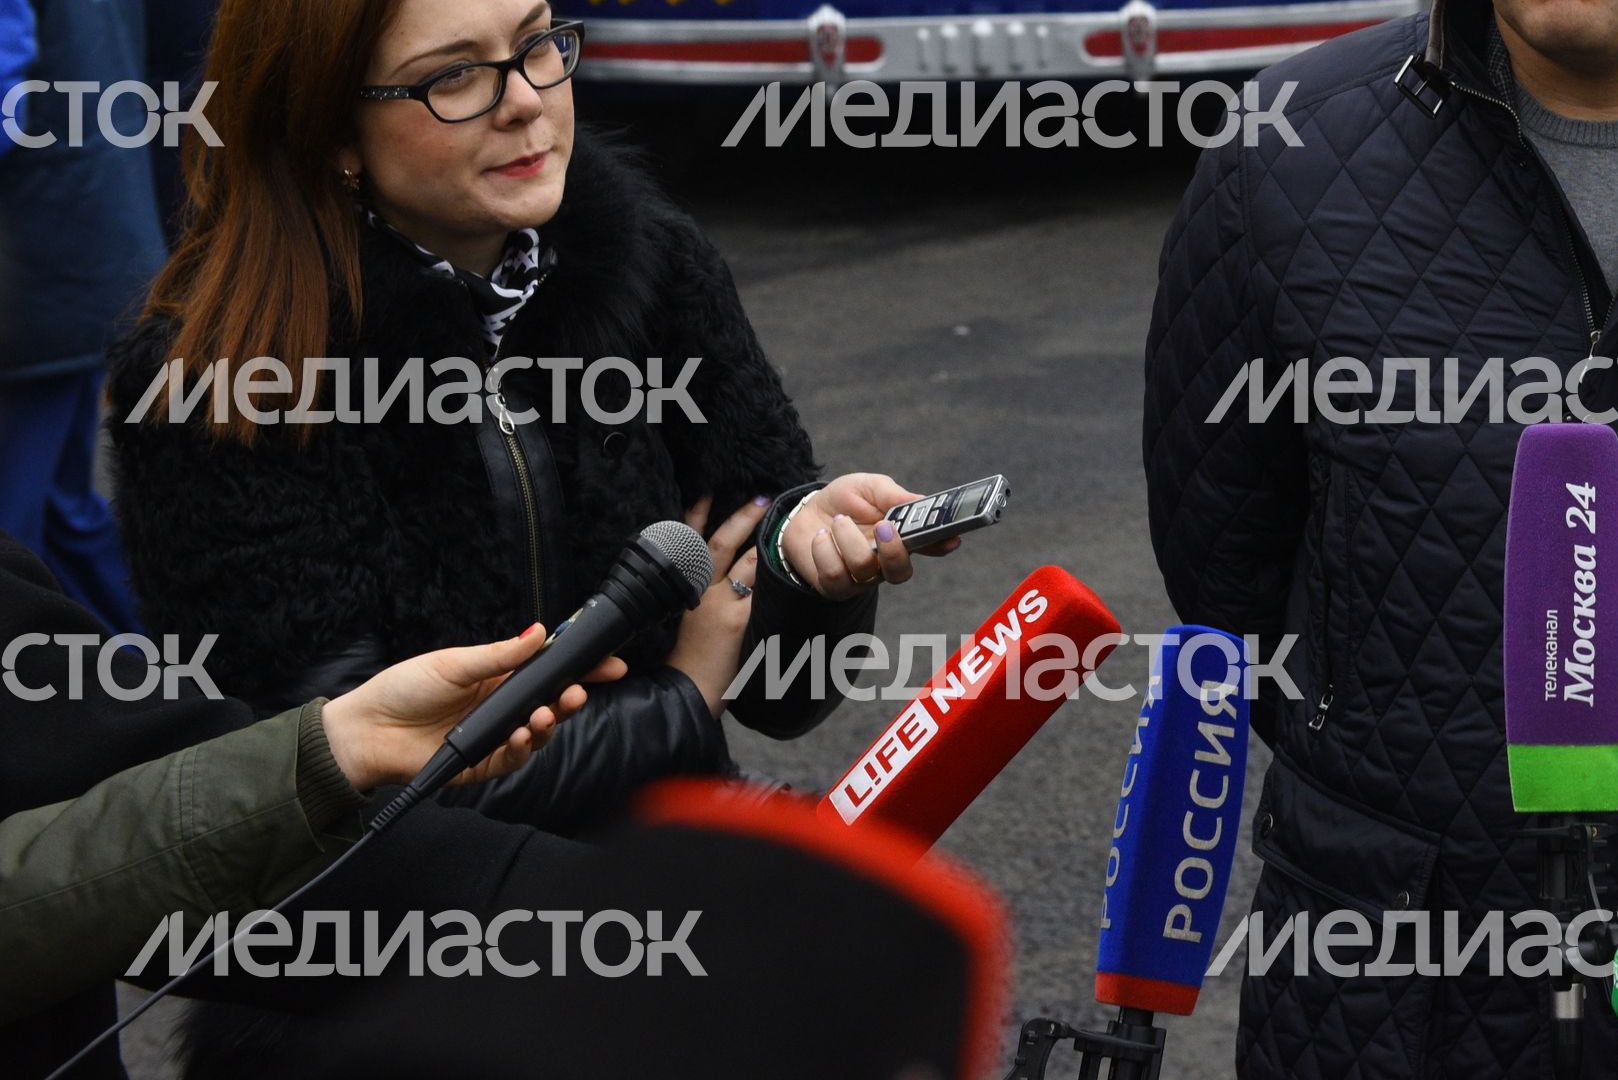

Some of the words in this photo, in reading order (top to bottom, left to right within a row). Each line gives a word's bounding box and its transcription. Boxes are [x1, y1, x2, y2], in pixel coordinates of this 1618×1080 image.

[1565, 482, 1597, 534] 24
[930, 588, 1048, 715] NEWS
[1545, 608, 1558, 702] телеканал
[1564, 544, 1597, 708] Москва
[1162, 679, 1239, 943] РОССИЯ
